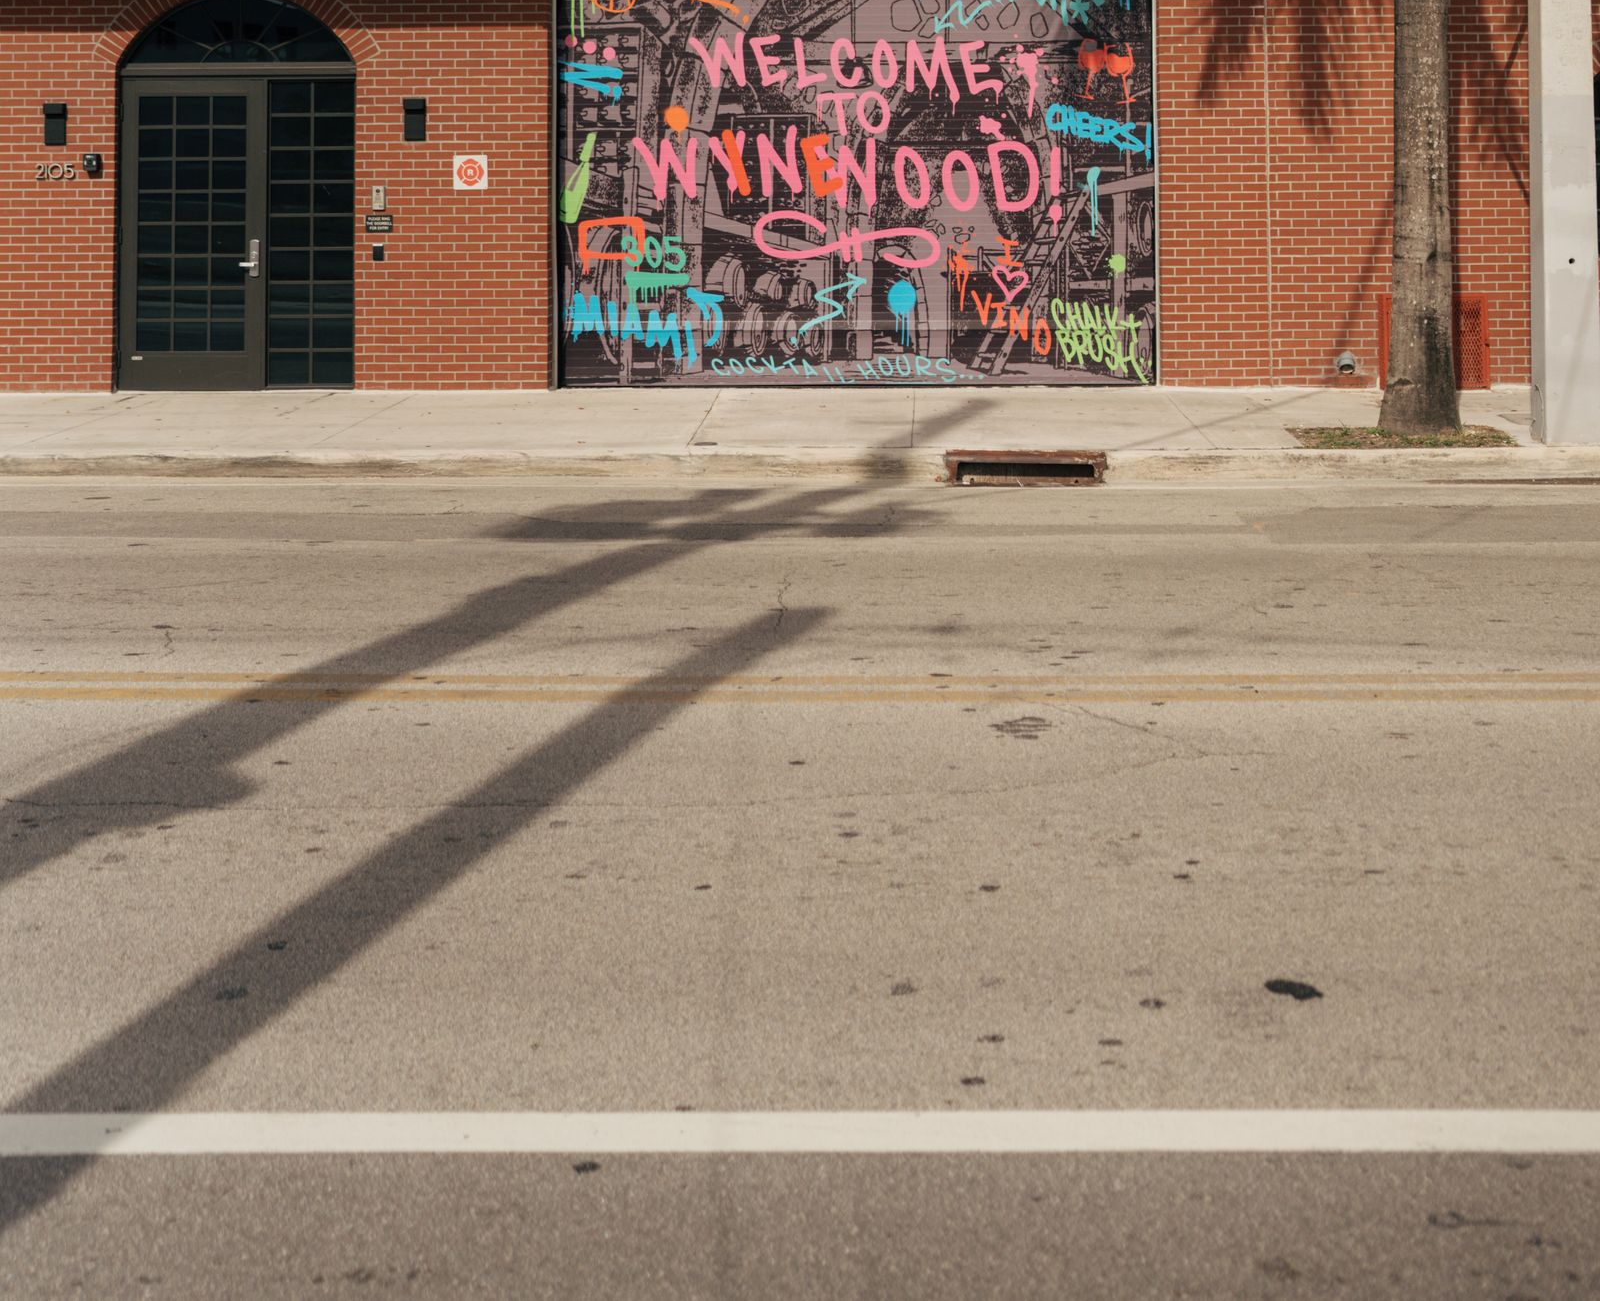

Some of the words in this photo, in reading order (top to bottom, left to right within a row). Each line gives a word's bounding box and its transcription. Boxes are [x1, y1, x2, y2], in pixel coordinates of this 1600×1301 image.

[689, 33, 1003, 113] WELCOME
[816, 92, 891, 136] TO
[35, 163, 76, 180] 2105
[621, 235, 687, 272] 305
[571, 291, 697, 369] MIAMI
[971, 290, 1052, 356] VINO
[711, 355, 853, 385] COCKTAIL
